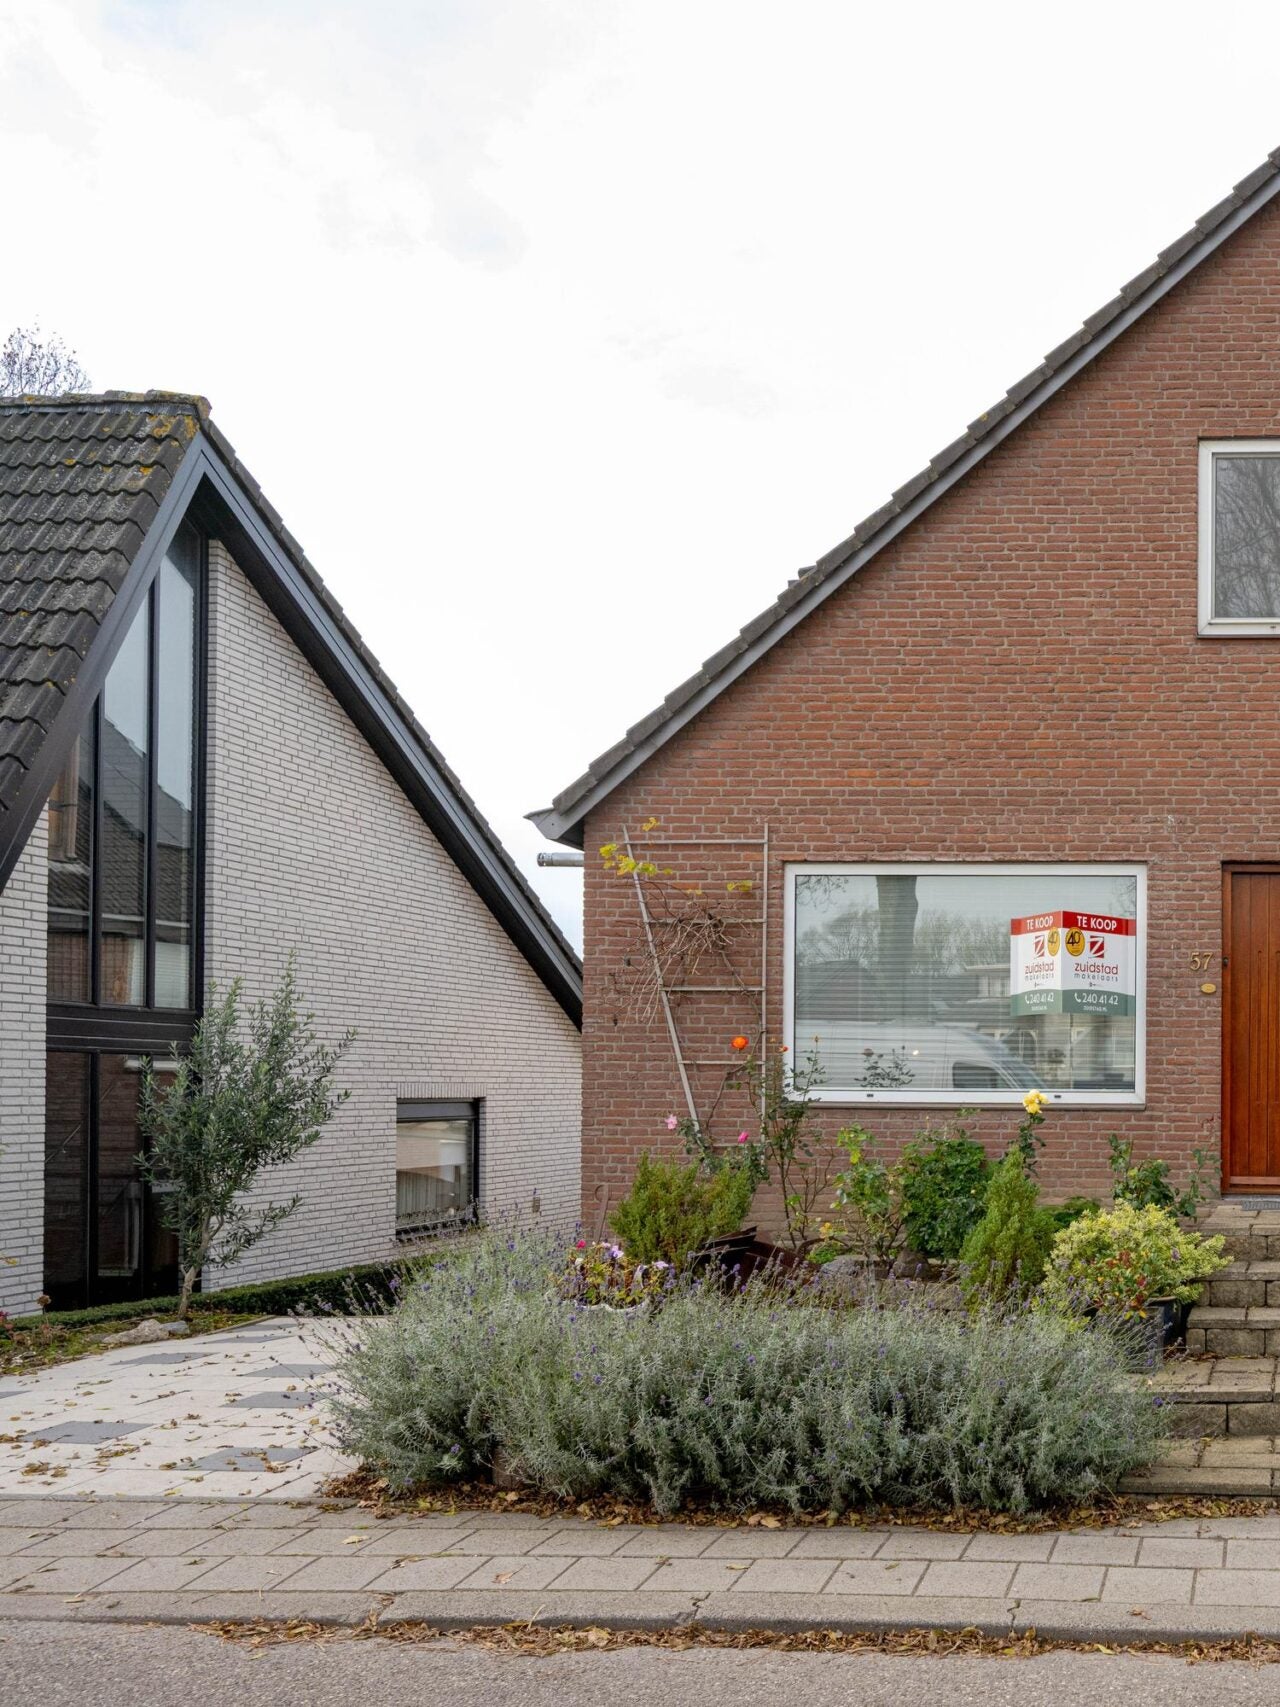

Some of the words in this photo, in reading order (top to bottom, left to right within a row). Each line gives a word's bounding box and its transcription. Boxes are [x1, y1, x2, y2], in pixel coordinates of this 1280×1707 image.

[1027, 919, 1034, 930] TE
[1035, 915, 1054, 929] KOOP
[1077, 915, 1088, 928] TE
[1091, 917, 1117, 931] KOOP
[1066, 931, 1082, 946] 40
[1025, 960, 1054, 975] zuidstad
[1074, 961, 1119, 975] zuidstad
[1190, 952, 1213, 972] 57
[1073, 973, 1118, 982] makelaars
[1082, 992, 1098, 1004] 240
[1098, 994, 1107, 1004] 41
[1108, 995, 1119, 1005] 42
